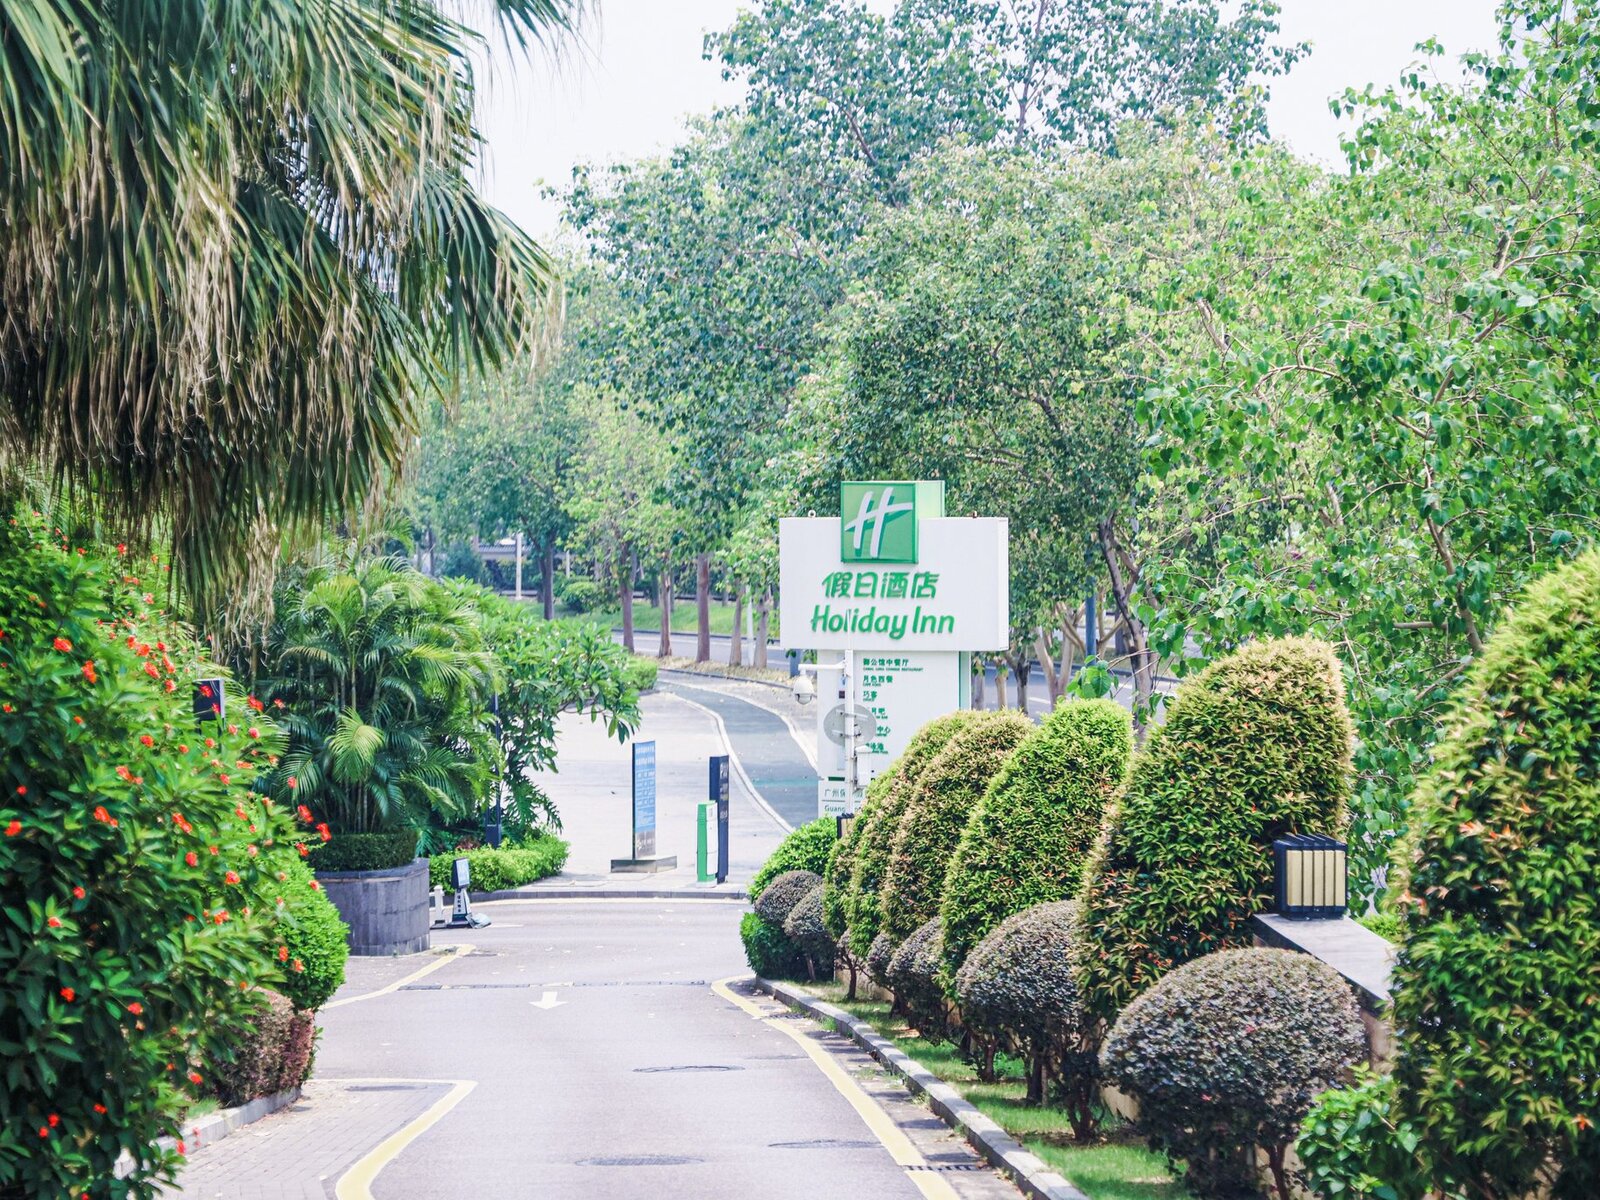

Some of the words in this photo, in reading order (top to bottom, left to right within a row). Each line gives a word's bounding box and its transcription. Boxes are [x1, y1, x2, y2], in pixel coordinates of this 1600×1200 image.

[821, 571, 939, 599] 假日酒店
[811, 604, 908, 640] Holiday
[912, 605, 956, 634] Inn
